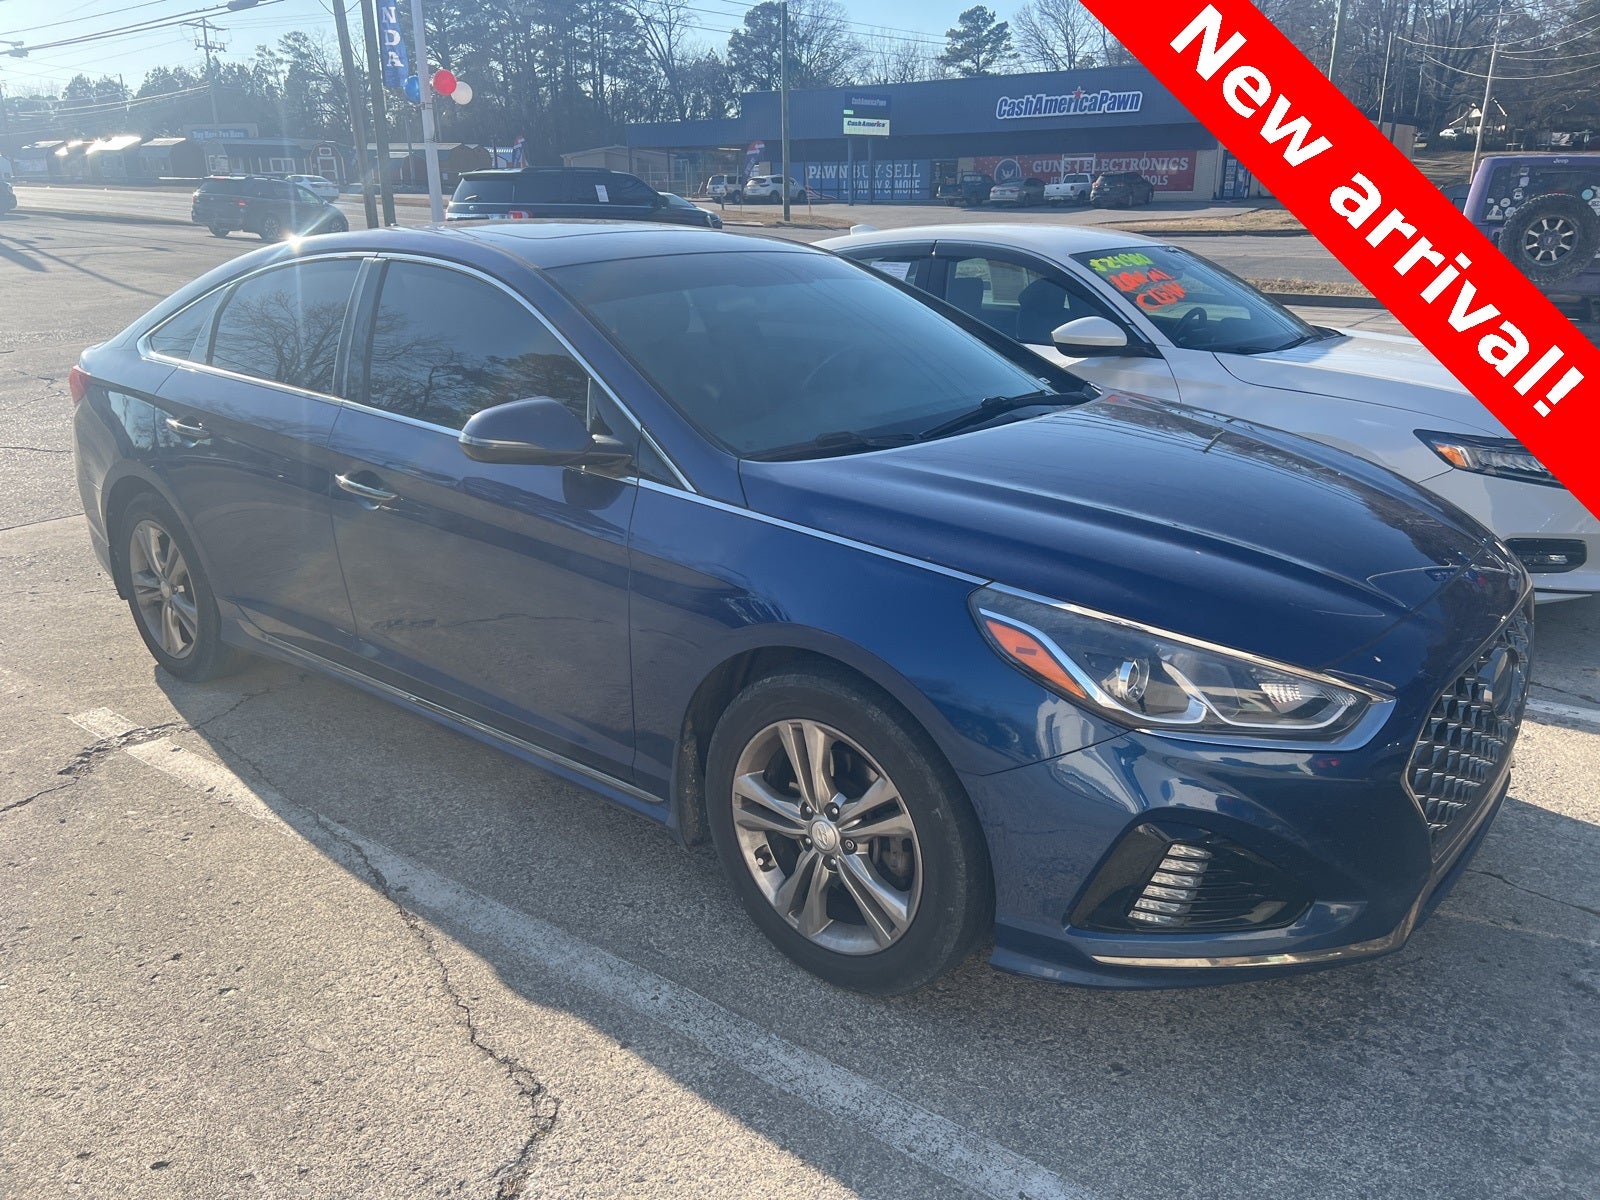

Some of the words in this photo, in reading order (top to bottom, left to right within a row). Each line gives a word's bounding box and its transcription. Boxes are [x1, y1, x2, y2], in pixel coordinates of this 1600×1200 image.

[996, 89, 1145, 119] CashAmericaPawn
[808, 165, 848, 179] PAWN
[1033, 160, 1075, 173] GUNS
[1083, 157, 1189, 172] ELECTRONICS
